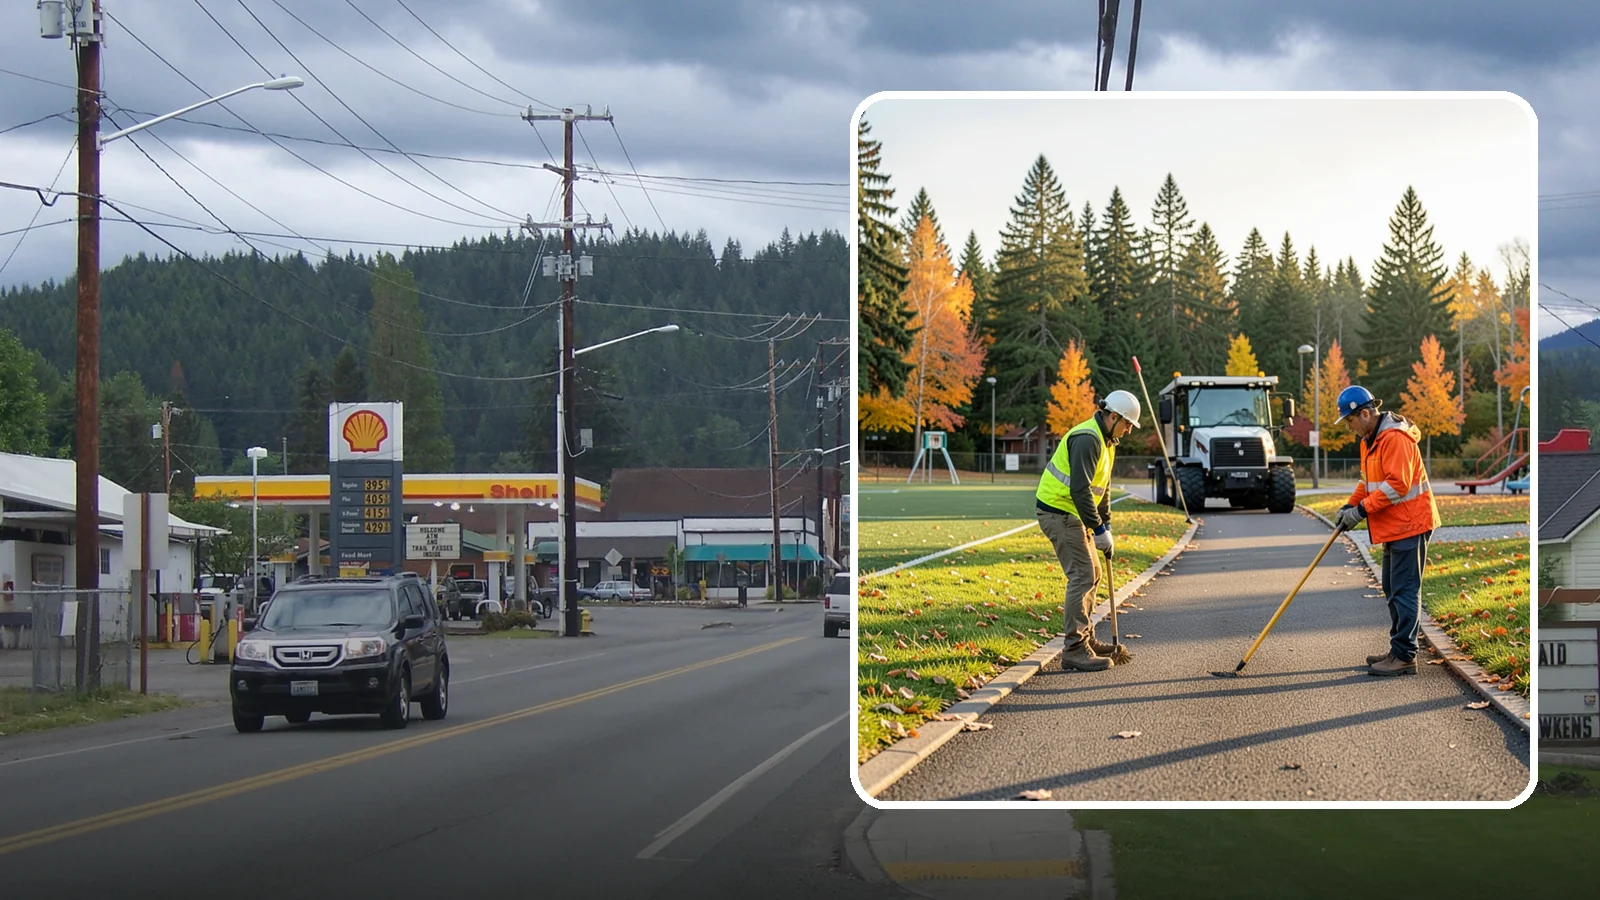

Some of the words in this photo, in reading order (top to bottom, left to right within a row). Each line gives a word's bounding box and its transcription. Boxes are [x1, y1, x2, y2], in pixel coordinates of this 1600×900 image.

[365, 480, 383, 490] 395
[490, 484, 547, 499] Shell
[365, 494, 383, 504] 405
[365, 508, 383, 518] 415
[365, 522, 383, 533] 429
